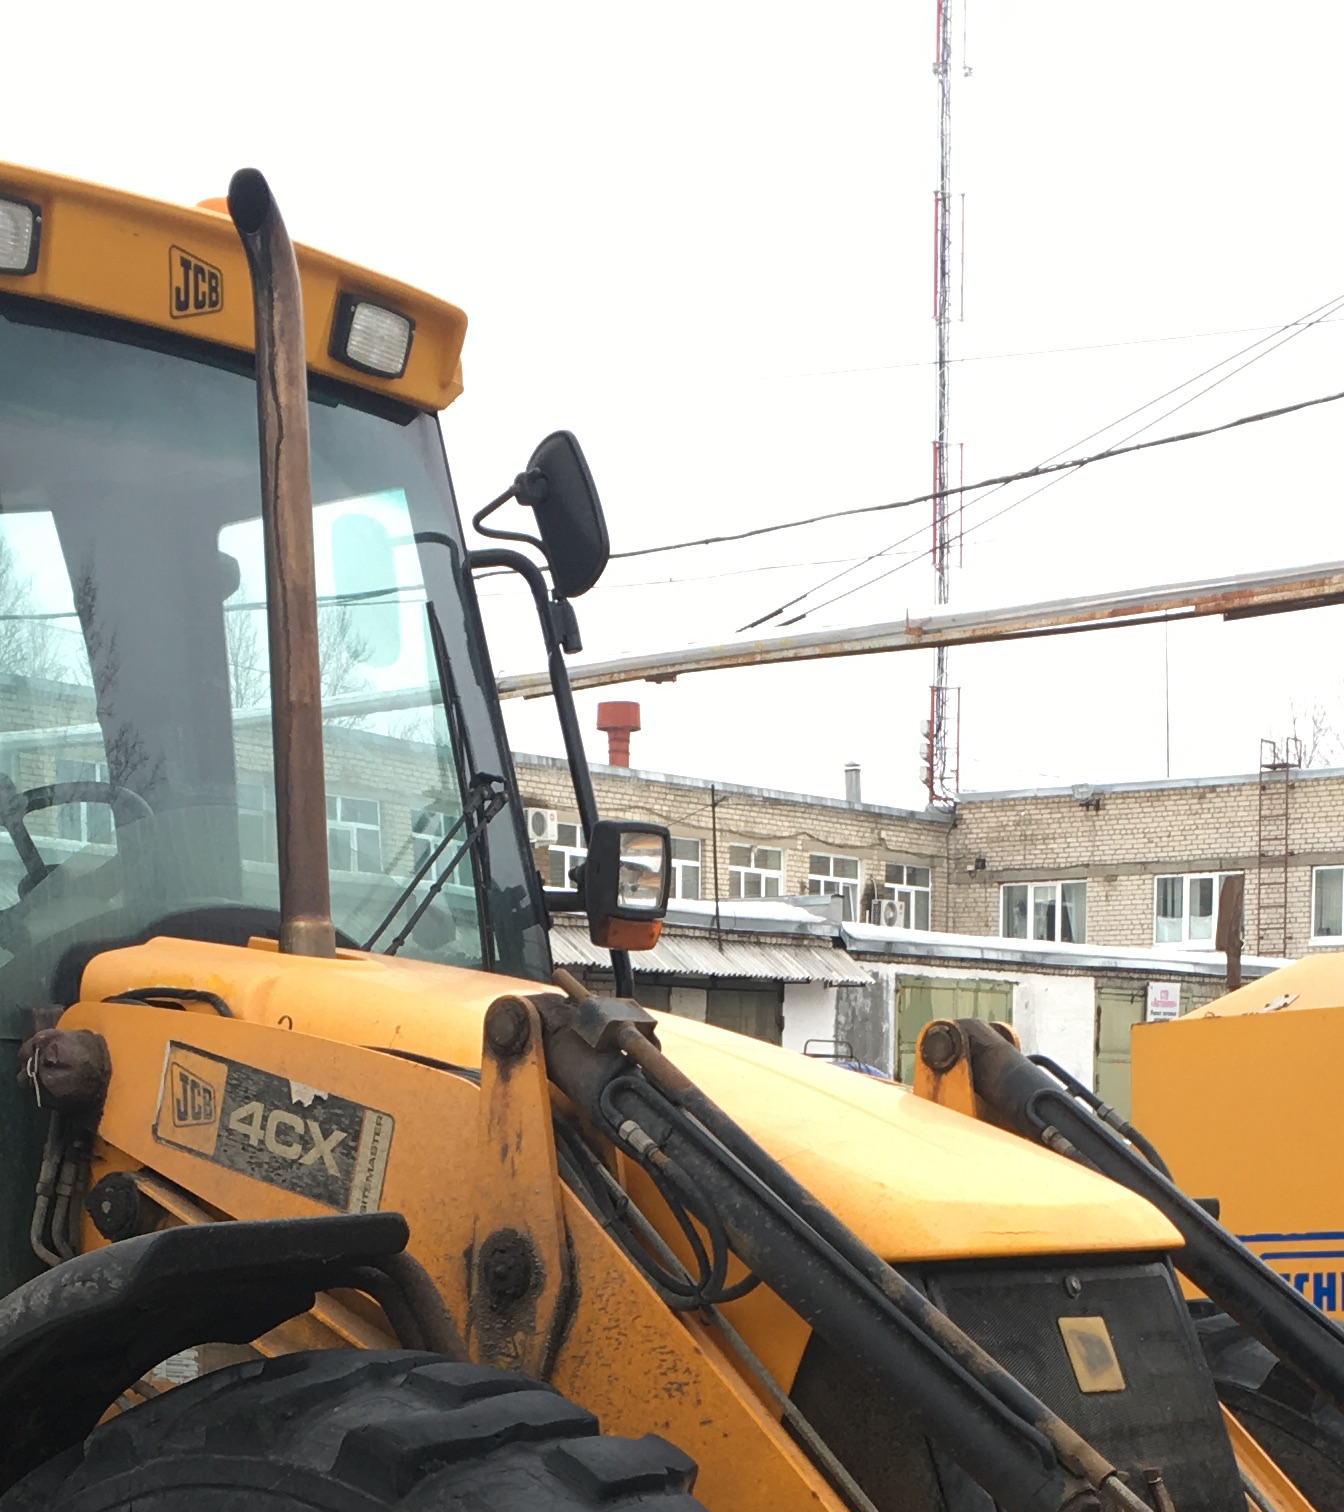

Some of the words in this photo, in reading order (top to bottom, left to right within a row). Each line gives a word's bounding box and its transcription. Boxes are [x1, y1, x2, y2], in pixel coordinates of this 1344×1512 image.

[175, 255, 219, 311] JCB
[175, 1071, 213, 1121] JCB
[229, 1101, 347, 1177] 4CX
[360, 1115, 384, 1214] SITEMASTER
